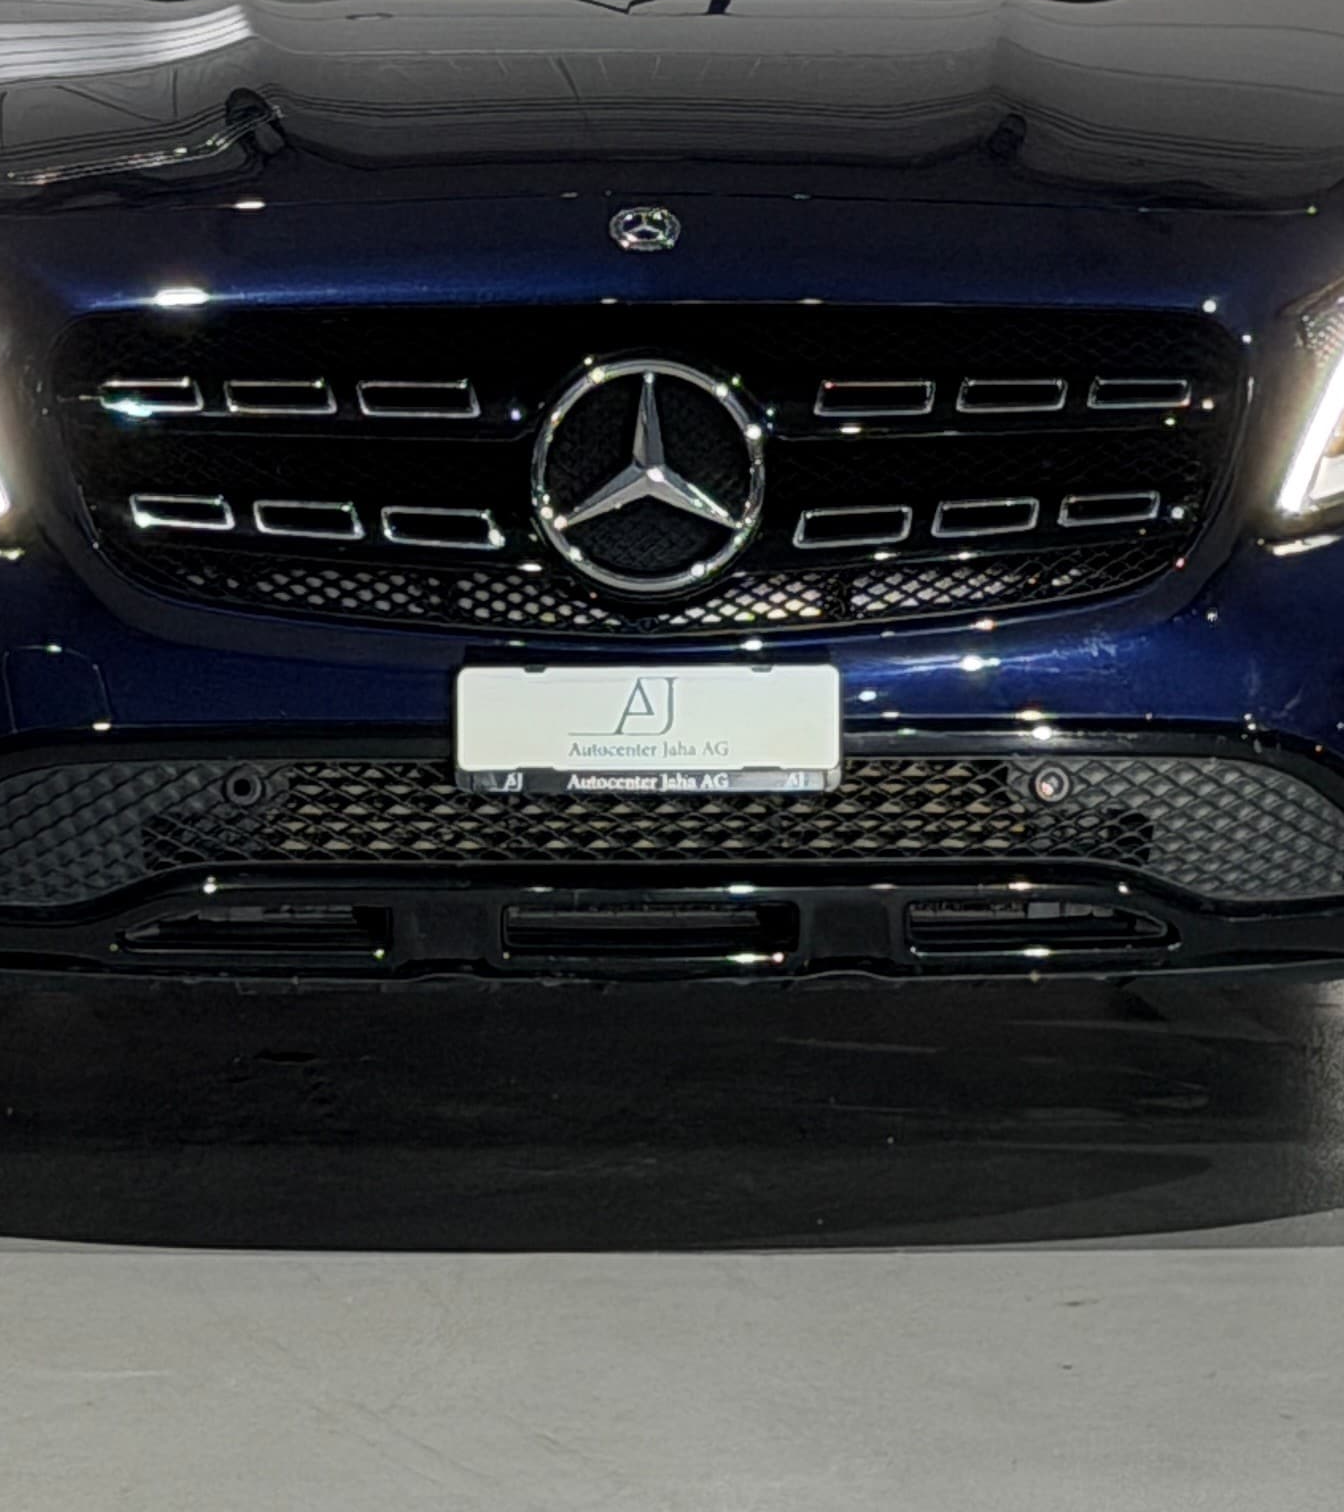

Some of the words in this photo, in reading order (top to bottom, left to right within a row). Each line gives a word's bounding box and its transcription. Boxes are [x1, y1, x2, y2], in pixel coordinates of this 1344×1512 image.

[613, 675, 680, 736] AJ
[567, 741, 657, 758] Autocenter
[661, 739, 698, 758] Jaha
[701, 739, 730, 757] AG
[501, 771, 524, 792] AJ
[566, 772, 658, 791] Autocenter
[659, 771, 698, 792] Jaha
[699, 771, 730, 791] AG
